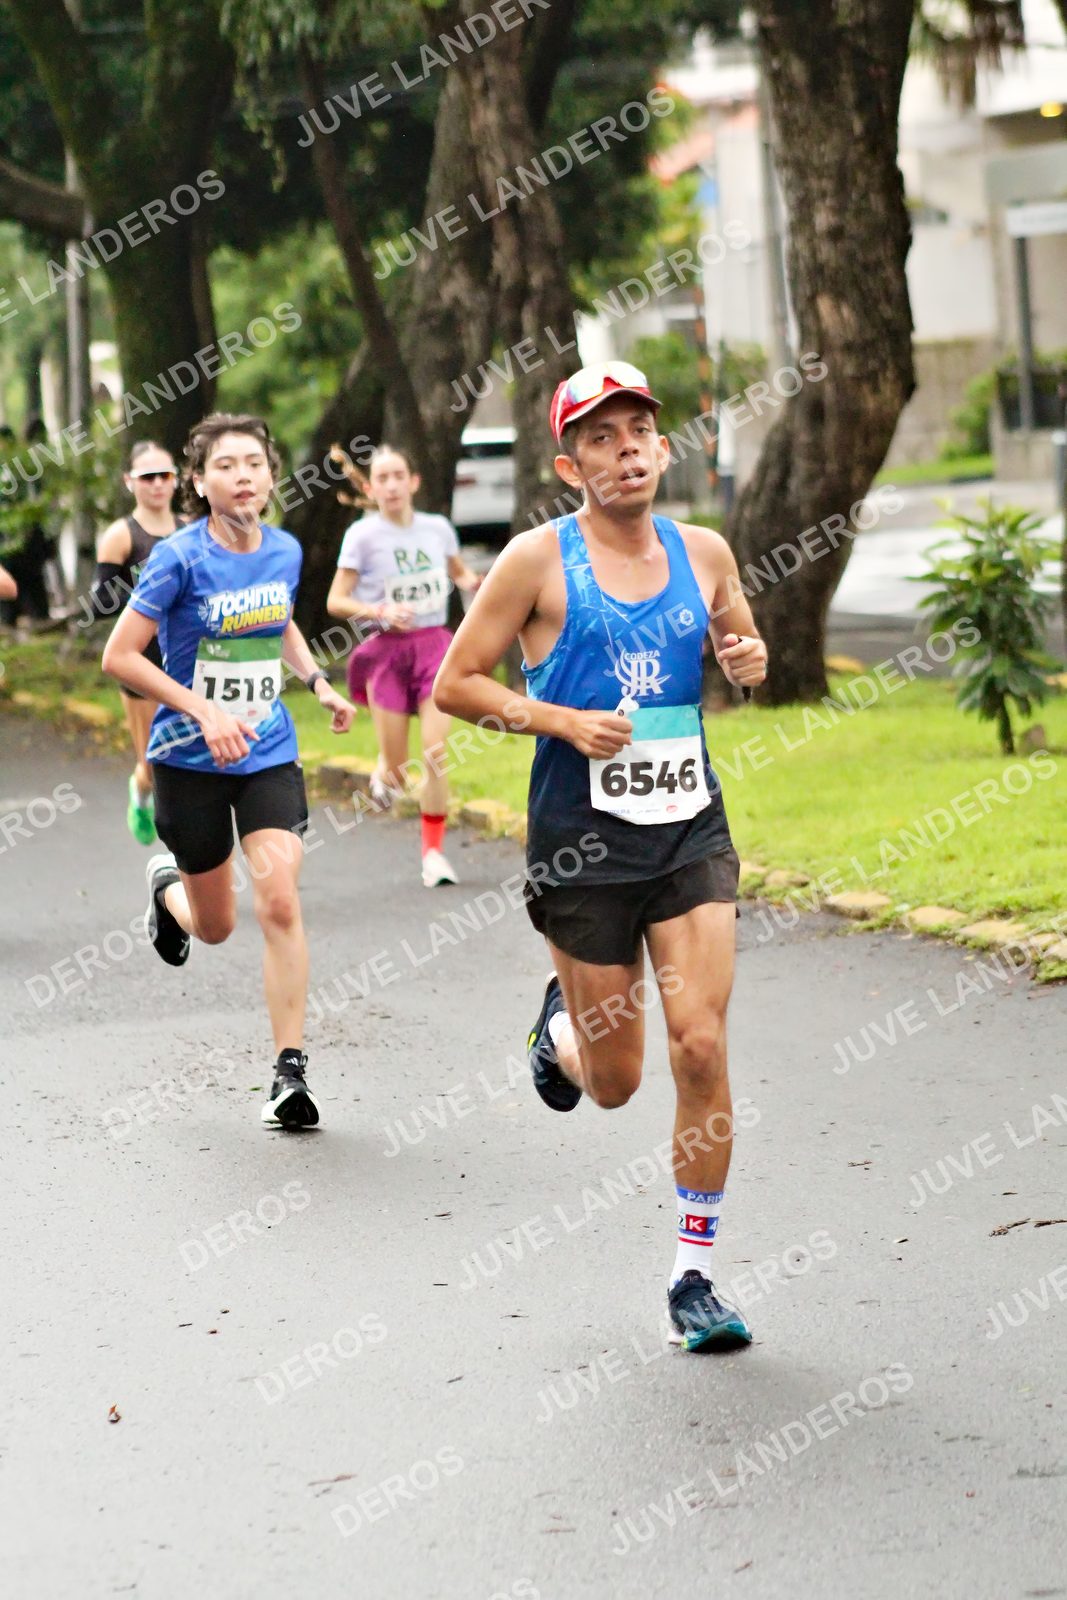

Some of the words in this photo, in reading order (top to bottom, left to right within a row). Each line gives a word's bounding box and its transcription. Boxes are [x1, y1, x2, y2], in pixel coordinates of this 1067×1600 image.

[208, 582, 288, 622] TOCHITOS
[221, 604, 288, 633] RUNNERS
[624, 650, 661, 660] CODEZA
[204, 676, 275, 702] 1518
[601, 758, 698, 797] 6546
